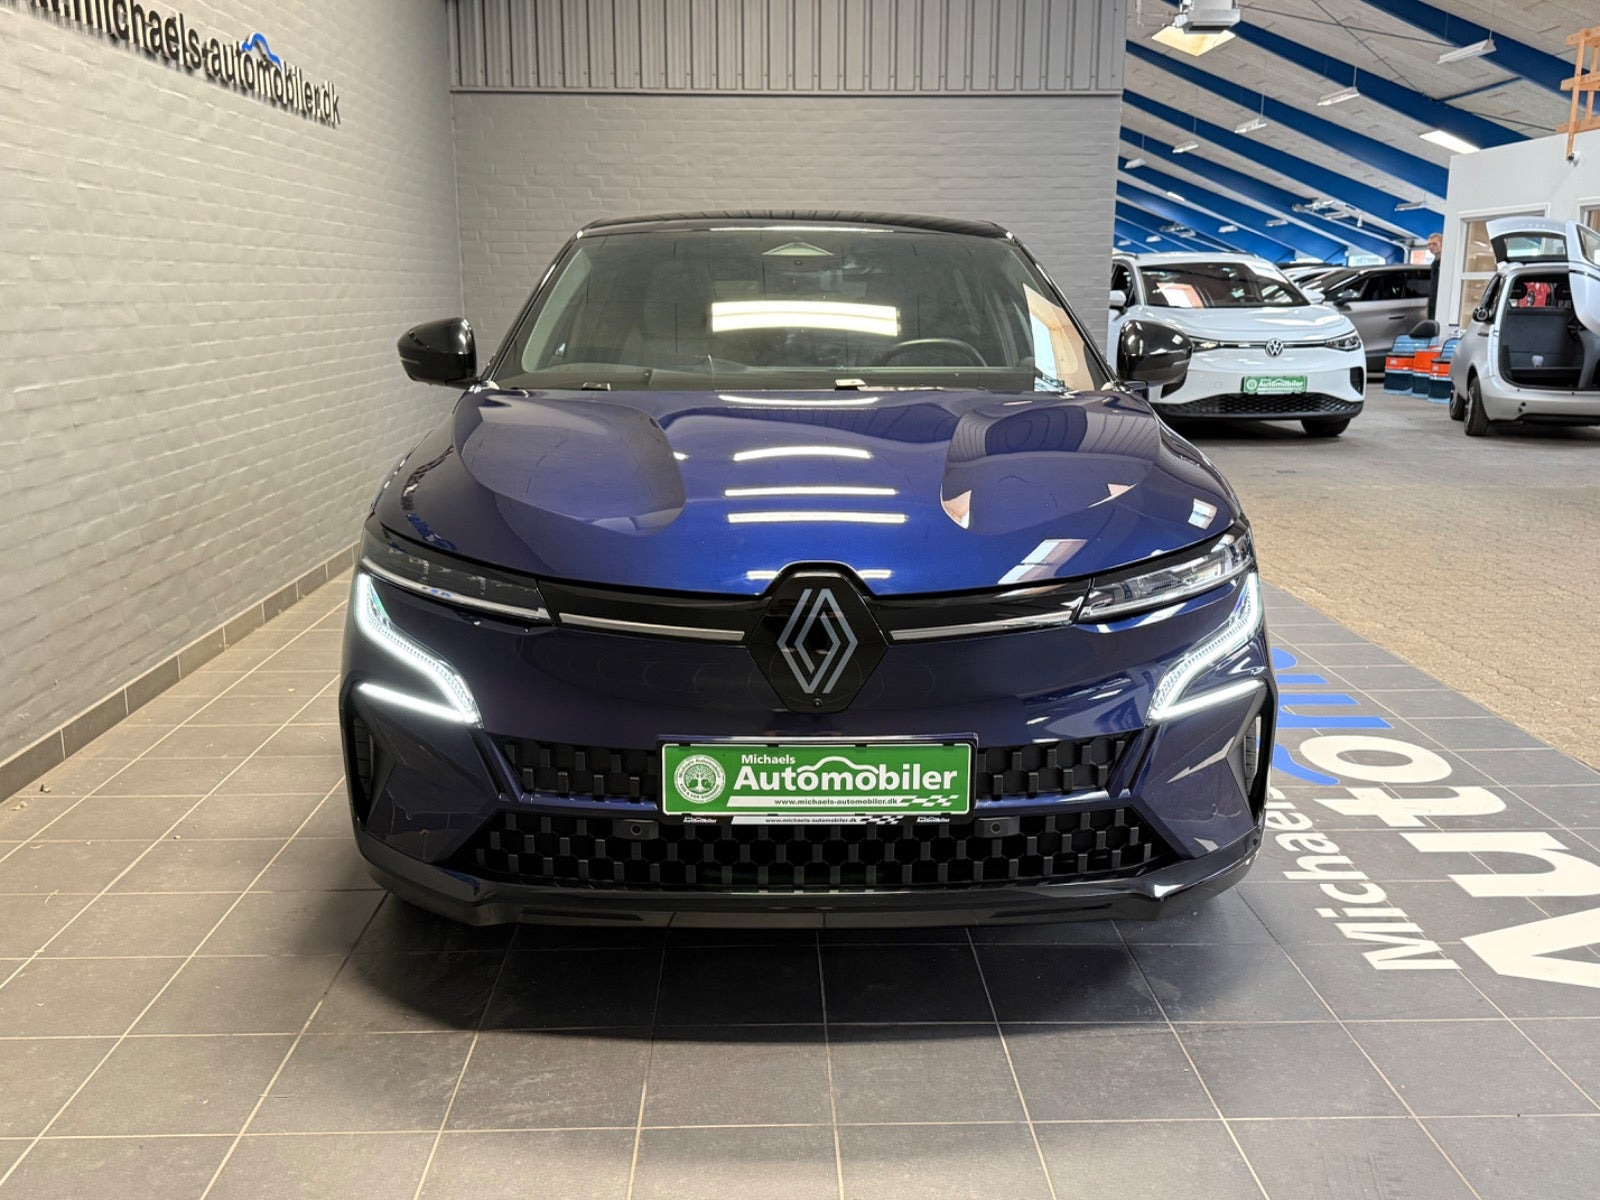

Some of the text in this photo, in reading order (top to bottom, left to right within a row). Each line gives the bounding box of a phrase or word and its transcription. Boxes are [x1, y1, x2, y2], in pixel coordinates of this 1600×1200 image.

[741, 754, 796, 765] Michaels
[733, 763, 958, 791] Automobiler
[774, 798, 898, 806] www.michaels-automobiler.dk
[1264, 786, 1462, 970] Michae
